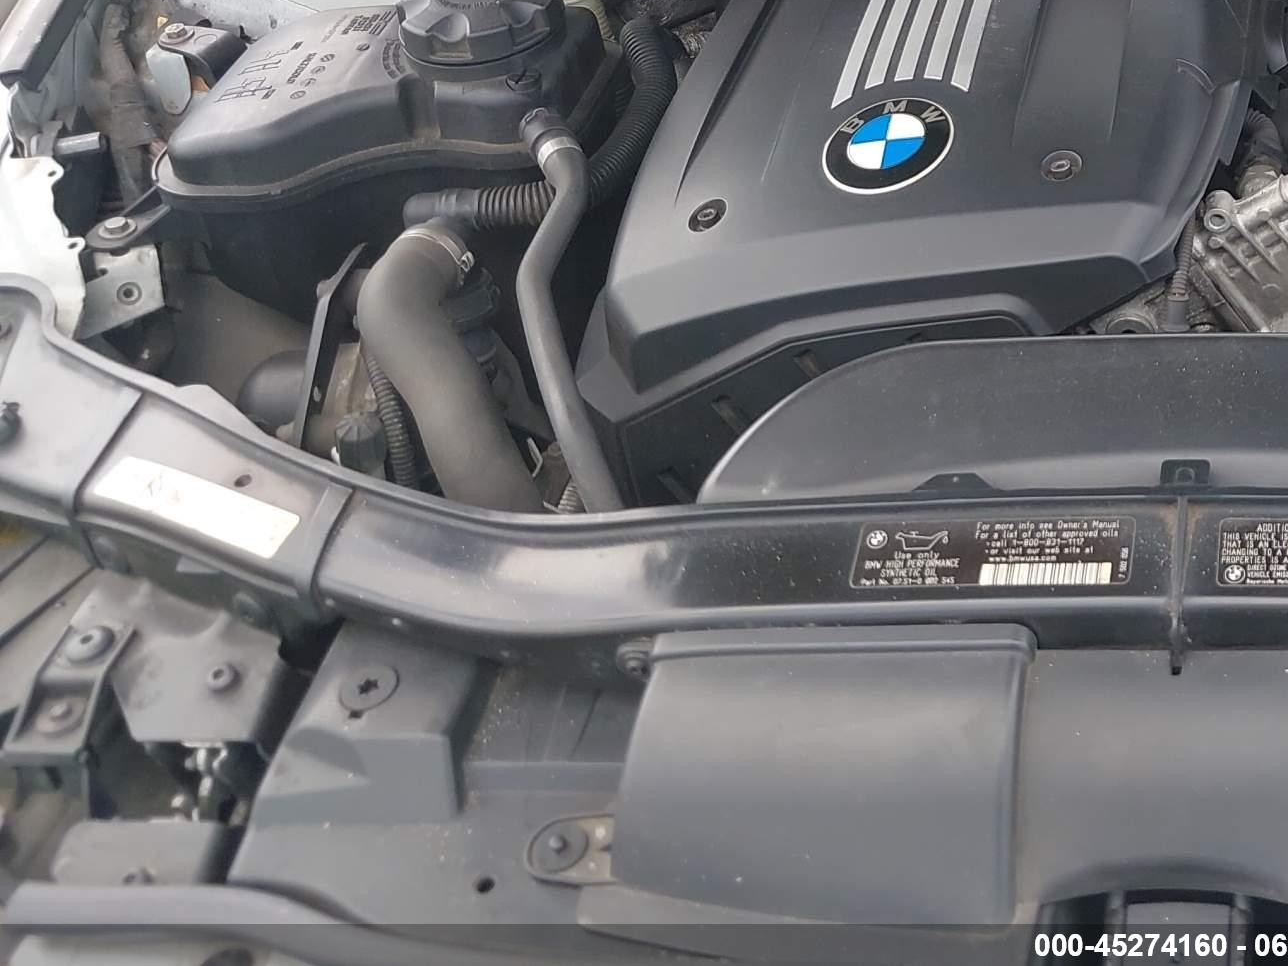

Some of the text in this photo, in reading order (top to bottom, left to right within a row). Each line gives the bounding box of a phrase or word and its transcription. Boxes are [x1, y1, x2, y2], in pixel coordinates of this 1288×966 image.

[840, 99, 946, 134] BMW
[976, 521, 990, 530] For
[1018, 521, 1035, 530] info
[1039, 522, 1053, 530] see
[1057, 520, 1088, 530] Owner's
[1092, 519, 1120, 529] Manual
[975, 530, 989, 539] For
[1003, 529, 1018, 538] list
[1022, 529, 1032, 538] of
[1035, 529, 1057, 538] other
[1061, 529, 1099, 539] approved
[1102, 528, 1118, 537] oils
[1223, 532, 1240, 541] THIS
[1244, 532, 1276, 541] VEHICLE
[1281, 532, 1288, 541] IS
[1012, 537, 1085, 547] 1-800-831-1117
[1223, 540, 1241, 548] THAT
[1246, 540, 1254, 548] IS
[1258, 540, 1269, 548] AN
[894, 550, 940, 560] Use only
[1003, 546, 1022, 555] visit
[1044, 546, 1060, 554] web
[1063, 546, 1081, 554] site
[1084, 545, 1094, 553] at
[1222, 547, 1259, 556] CHANGING
[1263, 548, 1273, 556] TO
[1276, 548, 1283, 556] A
[864, 558, 960, 570] BMW HIGH PERFORMANCE
[1221, 555, 1267, 564] PROPERTIES
[1271, 555, 1279, 564] IS
[1282, 556, 1288, 564] A
[880, 567, 938, 578] SYNTHETIC OIL
